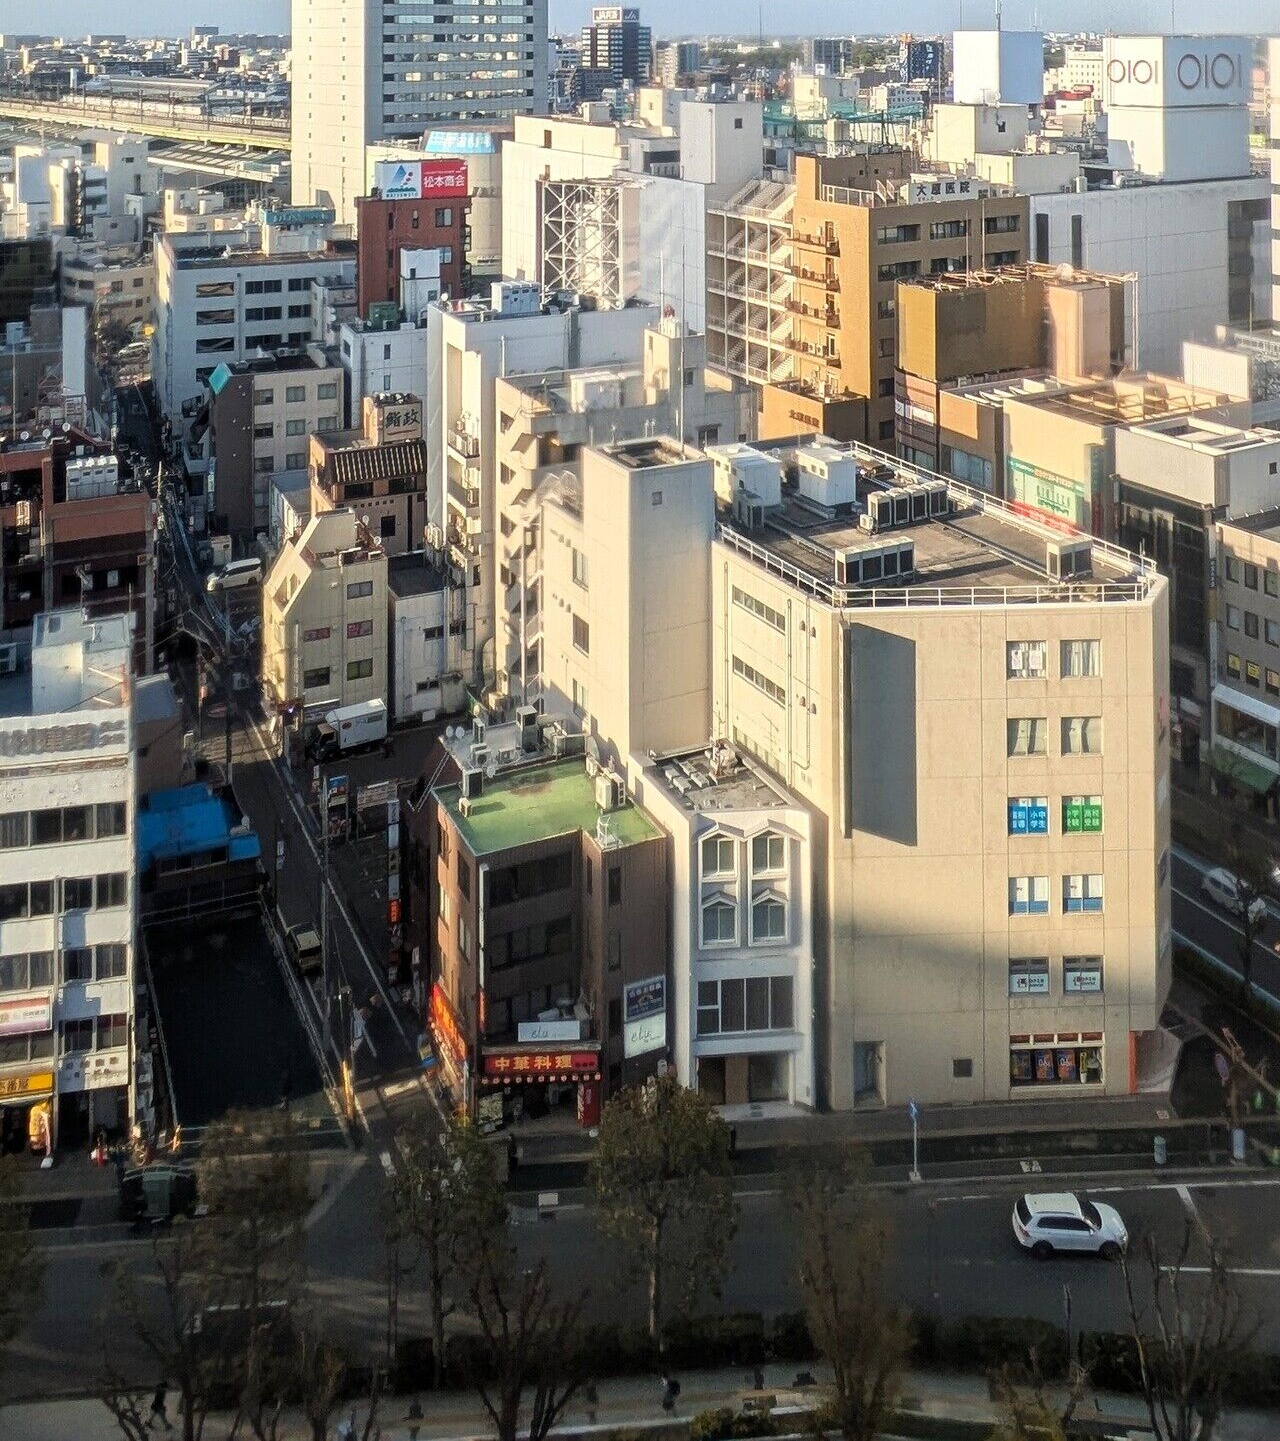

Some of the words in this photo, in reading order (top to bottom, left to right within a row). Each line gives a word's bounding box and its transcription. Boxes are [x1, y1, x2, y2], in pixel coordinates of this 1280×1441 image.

[423, 174, 465, 188] 松本商会
[494, 1055, 572, 1071] 中華料理
